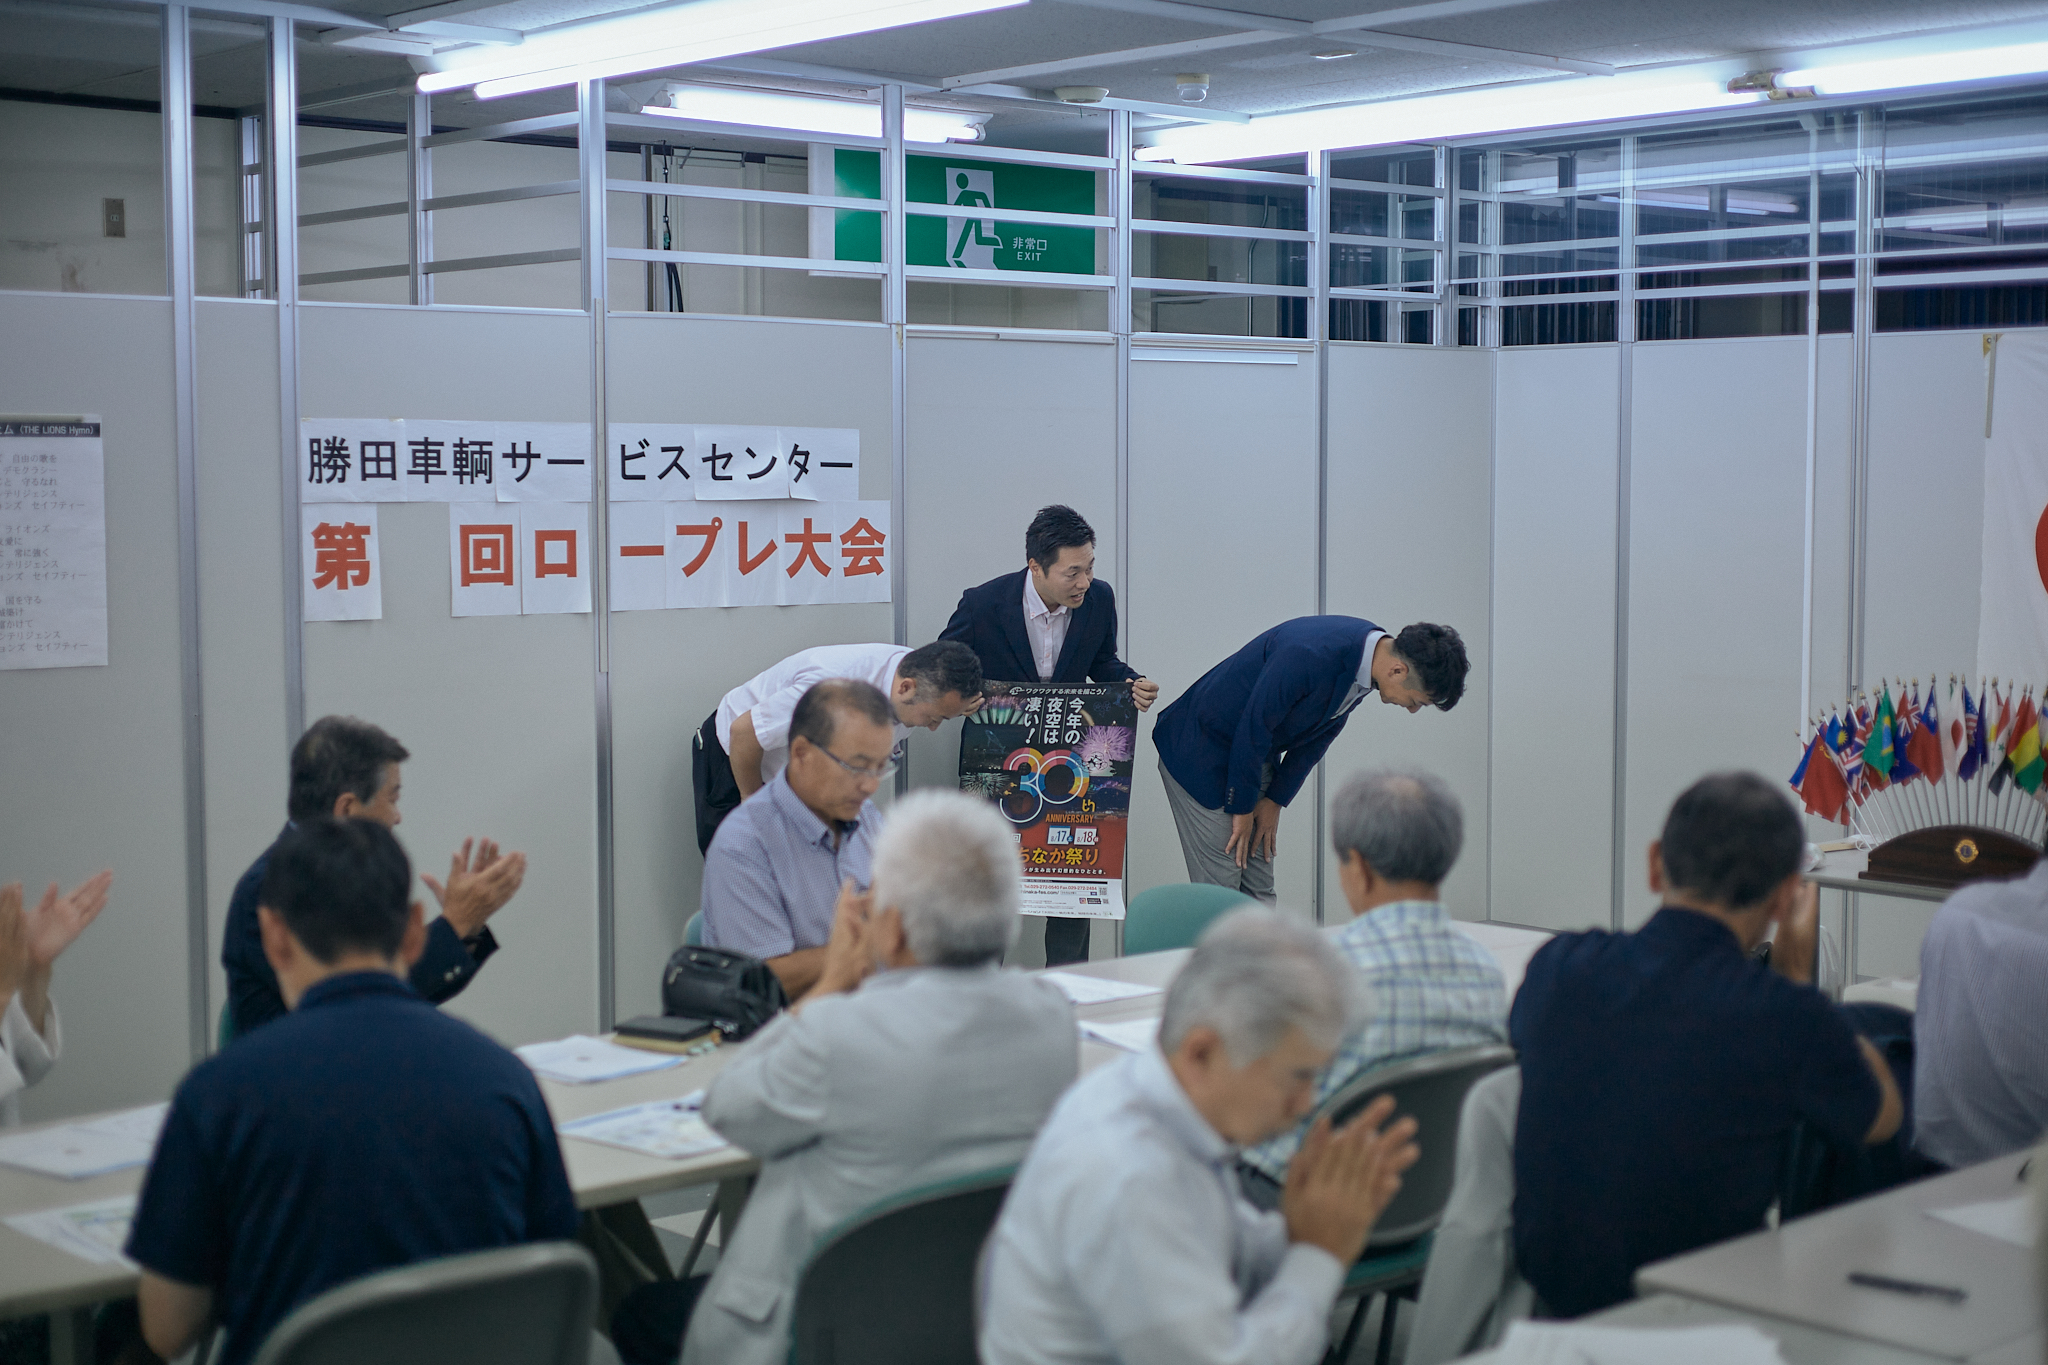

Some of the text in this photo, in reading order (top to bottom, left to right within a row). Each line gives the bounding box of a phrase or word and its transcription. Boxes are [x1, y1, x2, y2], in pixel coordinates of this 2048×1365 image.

[1013, 237, 1047, 250] 非常口
[1017, 252, 1041, 261] EXIT
[0, 424, 94, 436] ム (THE LIONS Hymn)
[12, 454, 57, 463] 自由の歌を
[0, 490, 57, 498] テリジェンス
[6, 525, 50, 533] ライオンズ
[311, 522, 372, 590] 第
[6, 595, 42, 605] 国を守る
[1024, 697, 1042, 744] 凄い!
[1044, 697, 1064, 744] 夜空は
[1065, 697, 1085, 745] 今年の
[1082, 799, 1096, 812] th
[1046, 814, 1094, 823] ANNIVERSARY
